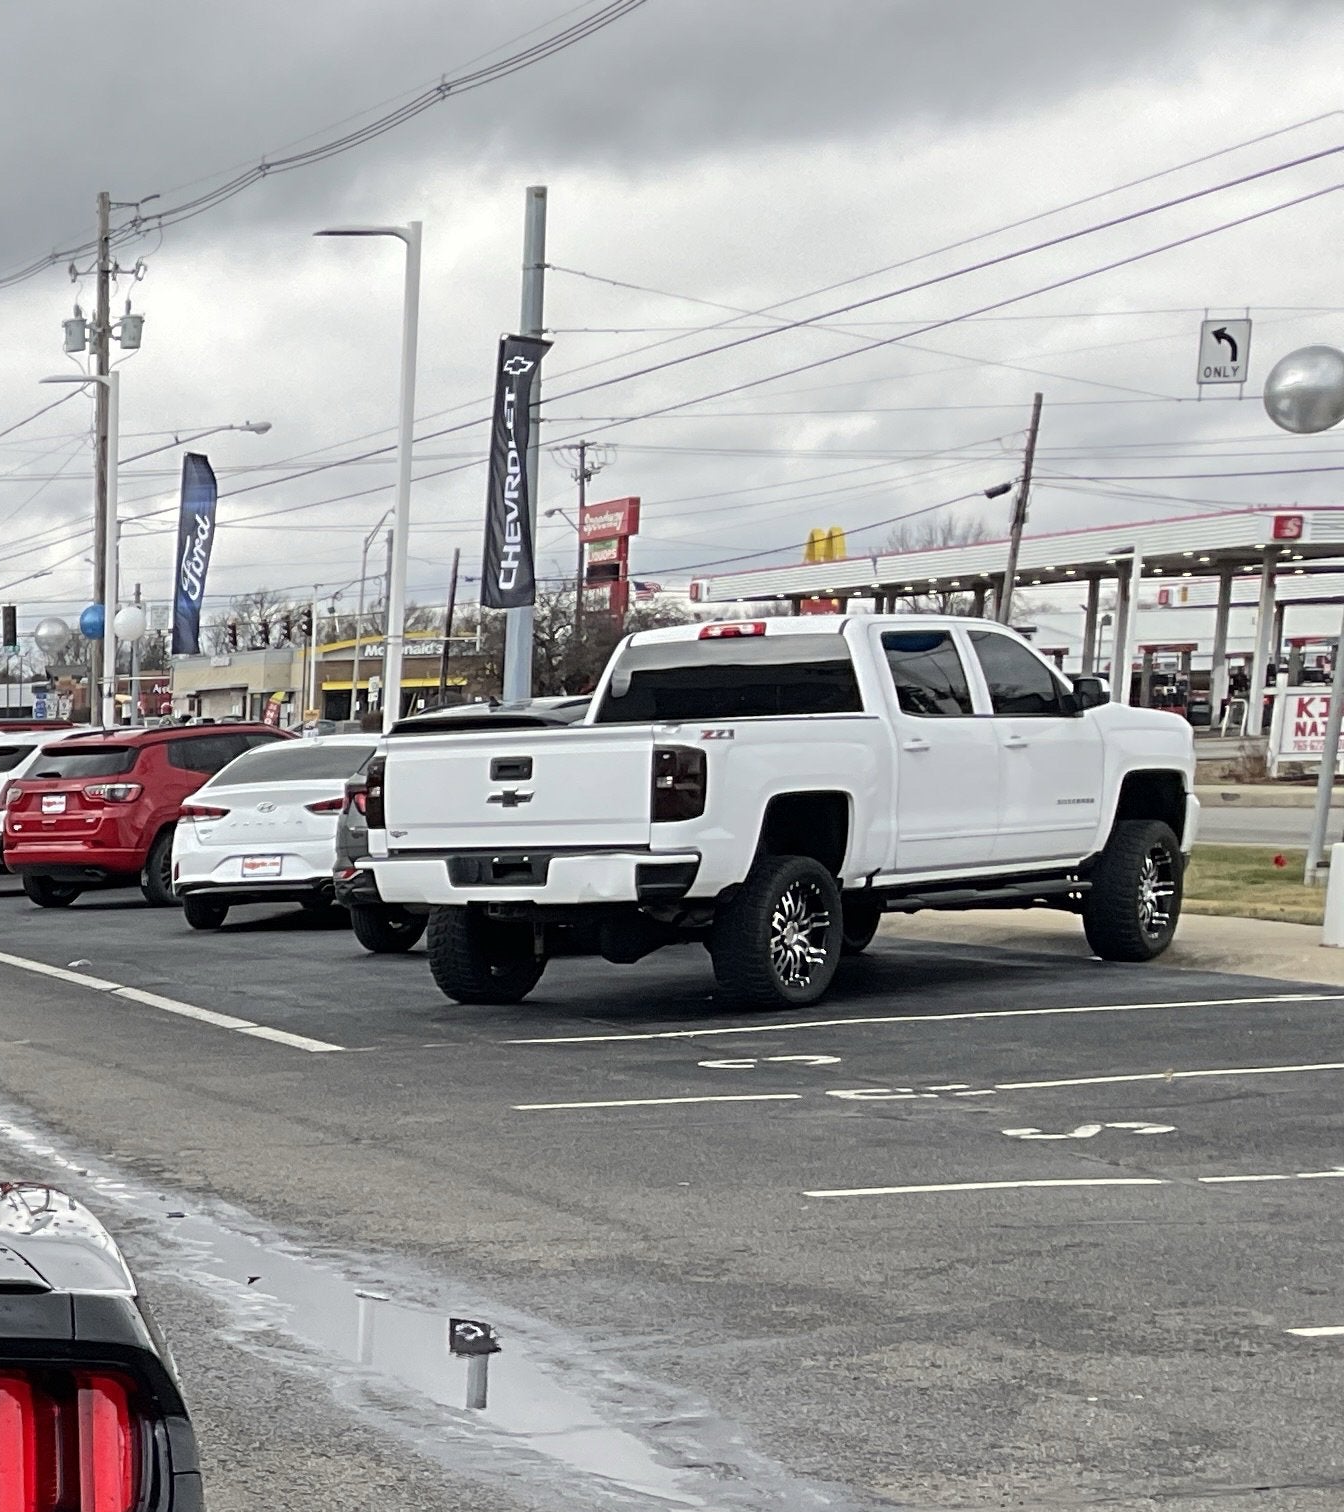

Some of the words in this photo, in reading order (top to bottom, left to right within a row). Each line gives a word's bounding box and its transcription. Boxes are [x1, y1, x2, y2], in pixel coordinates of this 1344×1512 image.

[1203, 366, 1240, 379] ONLY
[180, 513, 211, 601] Ford
[364, 643, 444, 657] Mcnald's
